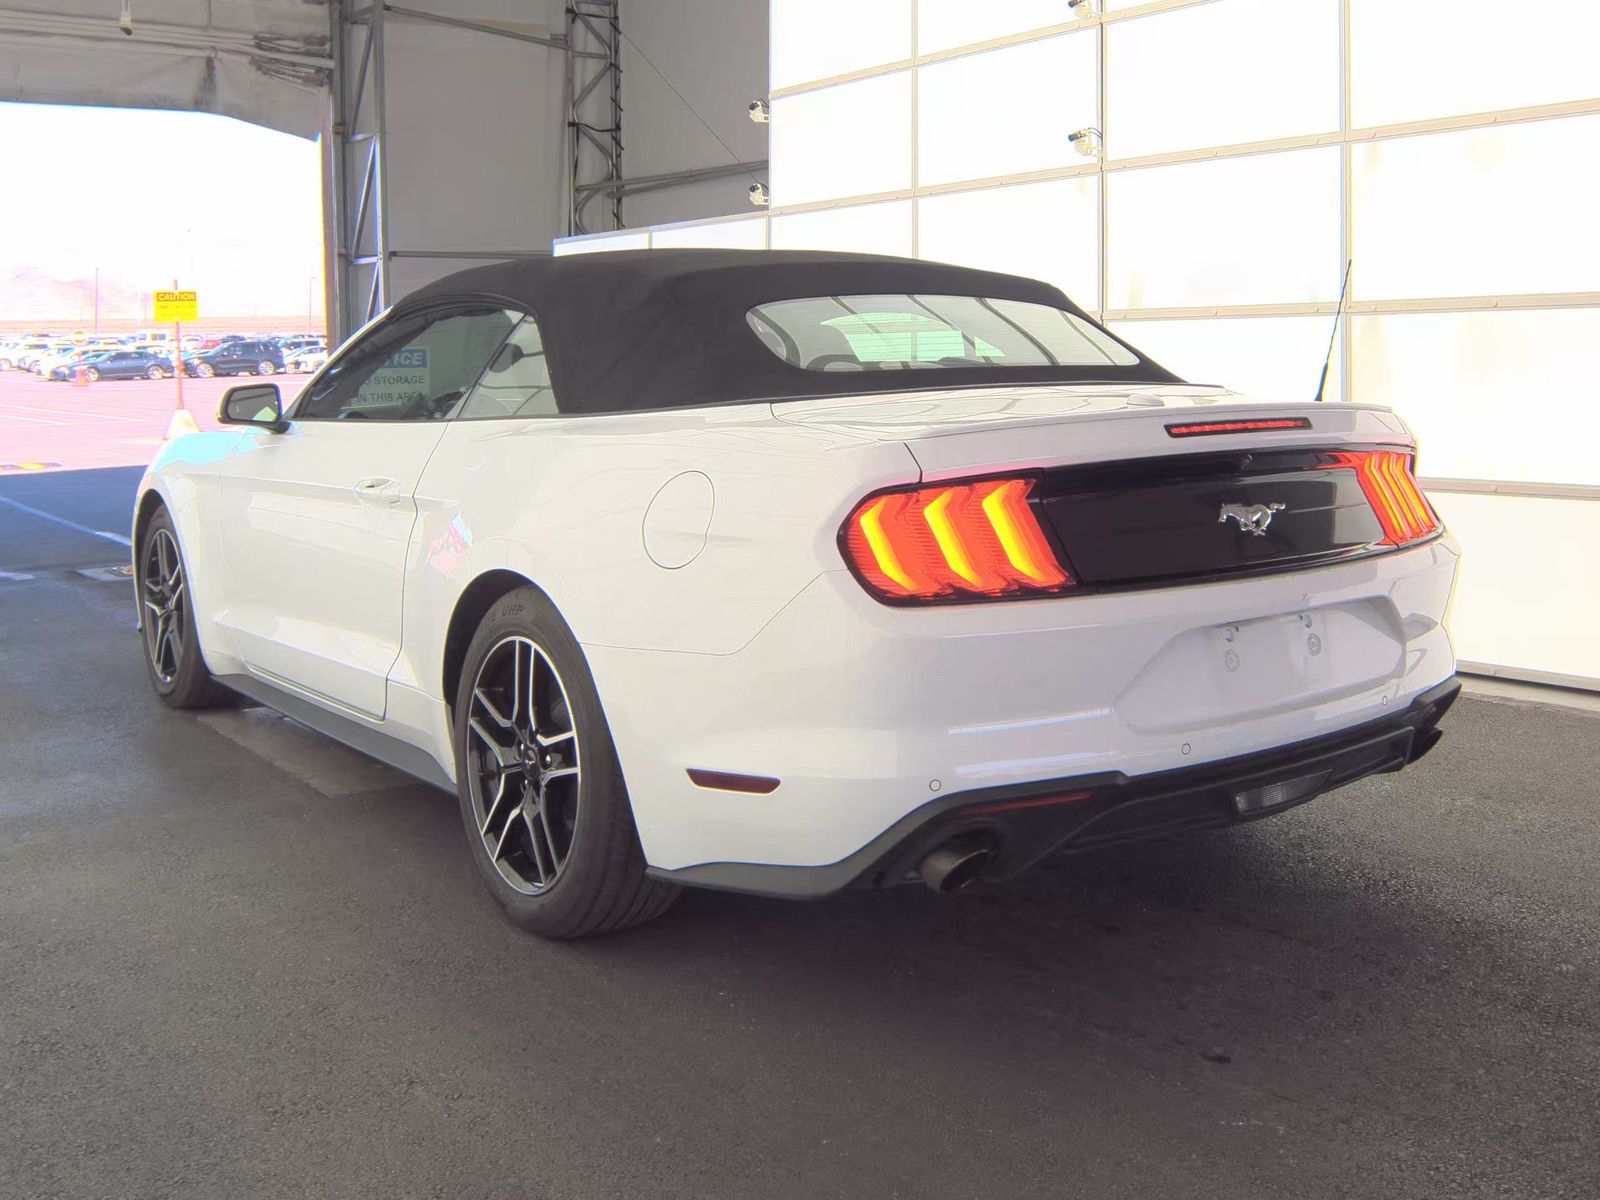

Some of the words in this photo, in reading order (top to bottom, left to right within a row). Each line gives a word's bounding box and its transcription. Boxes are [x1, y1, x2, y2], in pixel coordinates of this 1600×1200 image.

[158, 292, 195, 301] CAUTION
[385, 352, 424, 366] ICE
[374, 375, 425, 385] STORAGE
[369, 392, 393, 402] THIS
[397, 391, 424, 401] AR
